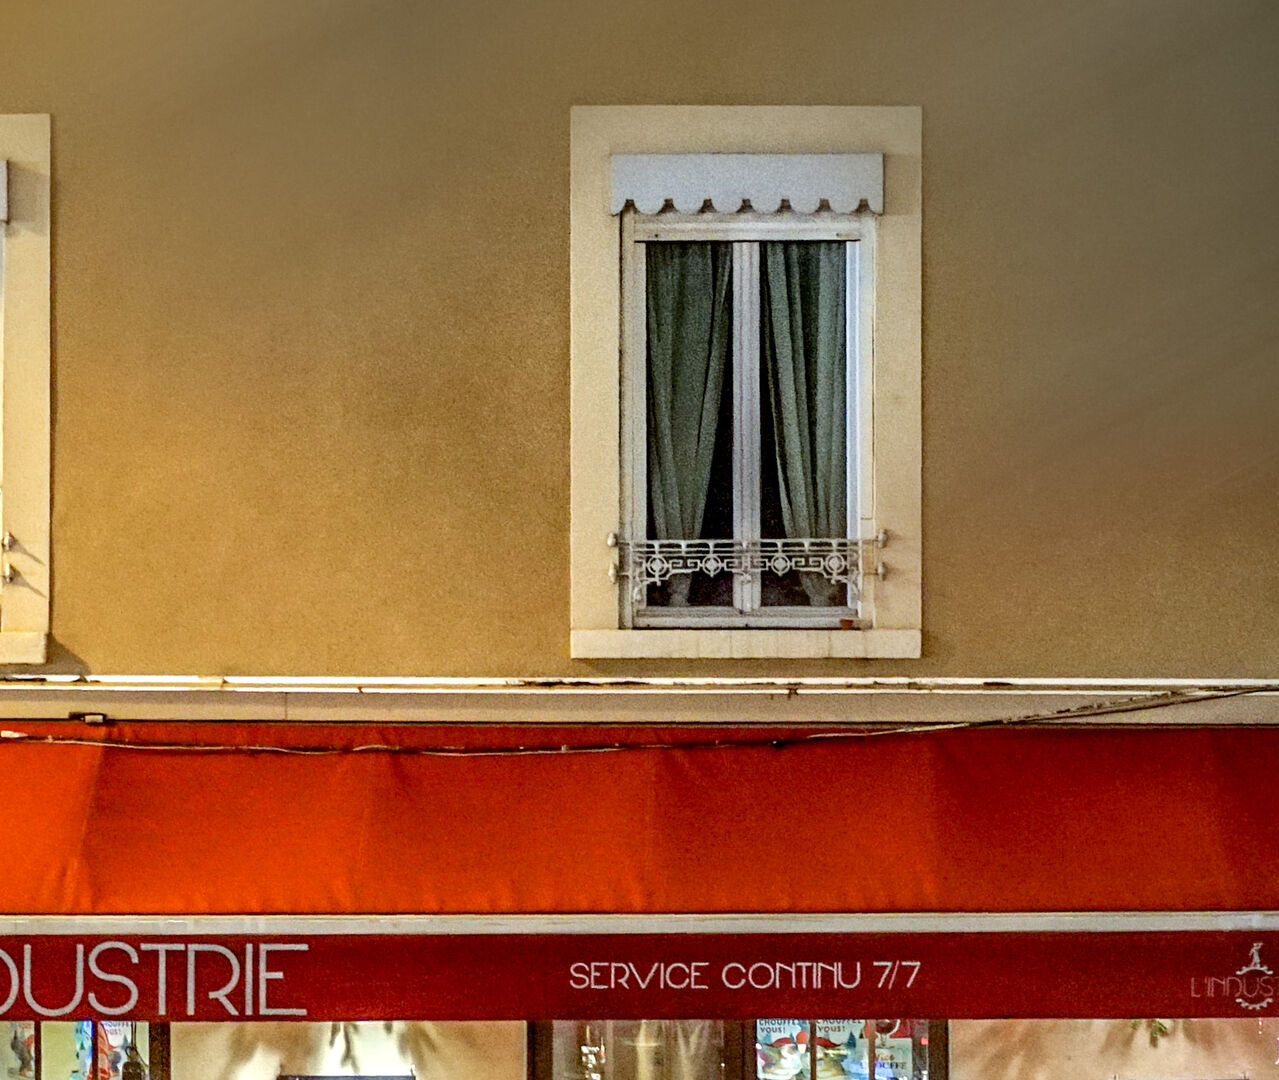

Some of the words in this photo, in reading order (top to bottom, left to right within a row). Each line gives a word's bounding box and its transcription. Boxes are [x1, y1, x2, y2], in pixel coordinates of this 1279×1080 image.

[570, 962, 709, 989] SERVICE
[722, 962, 861, 989] CONTINU
[873, 961, 920, 989] 7/7
[760, 1026, 786, 1034] VOUS!
